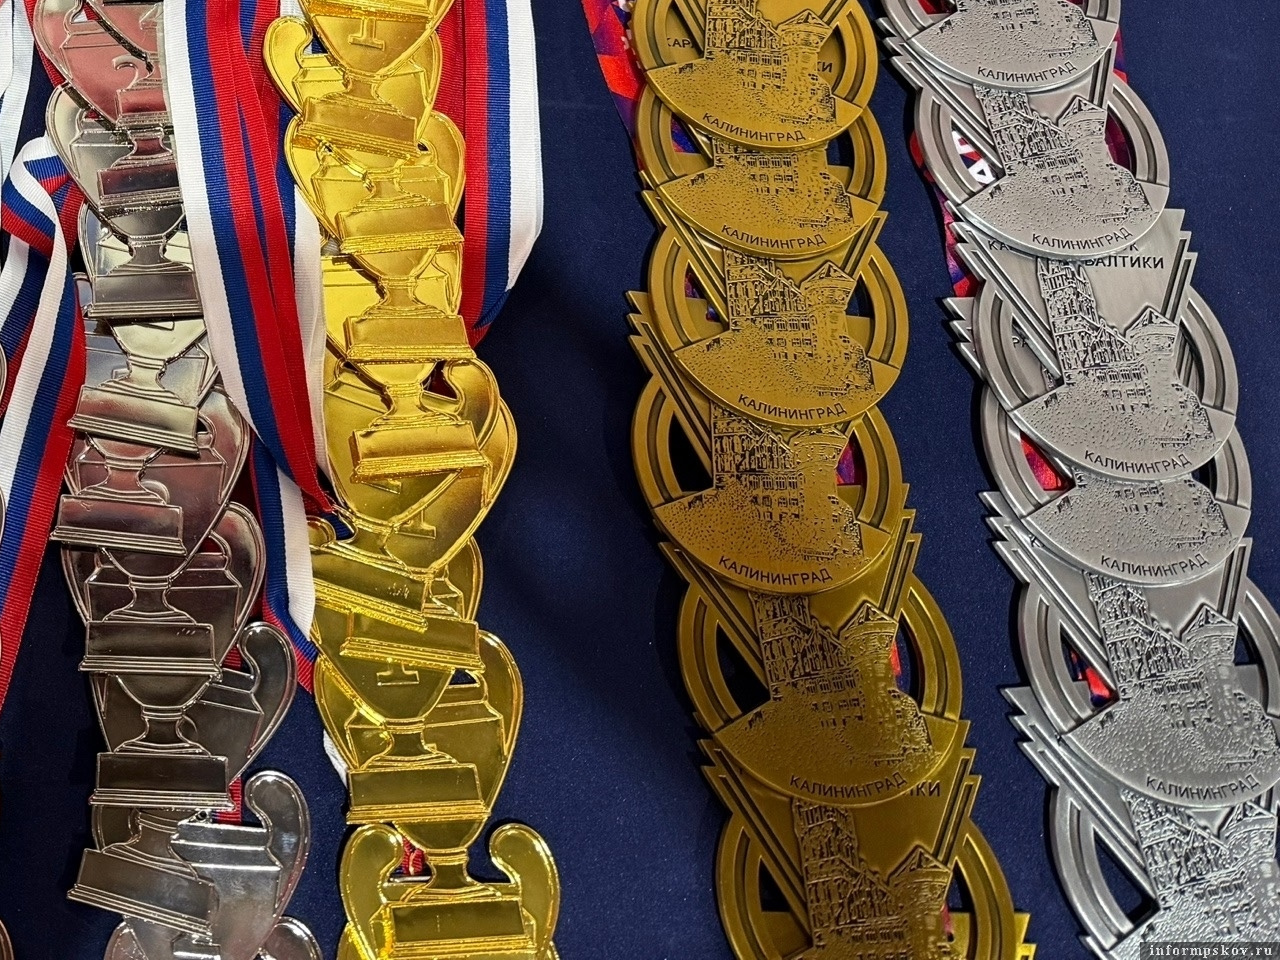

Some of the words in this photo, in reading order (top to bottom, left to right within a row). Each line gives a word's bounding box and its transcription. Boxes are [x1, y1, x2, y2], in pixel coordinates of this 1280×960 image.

[978, 61, 1078, 82] КАЛИНИНГРАД
[702, 112, 806, 142] КАЛИНИНГРАД
[721, 224, 827, 249] КАЛИНИНГРАД
[1032, 227, 1132, 251] КАЛИНИНГРАД
[738, 393, 847, 420] КАЛИНИНГРАД
[1084, 450, 1192, 474] КАЛИНИНГРАД
[718, 556, 833, 584] КАЛИНИНГРАД
[1101, 553, 1209, 579] КАЛИНИНГРАД
[789, 773, 907, 799] КАЛИНИНГРАД
[1146, 775, 1260, 802] КАЛИНИНГРАД
